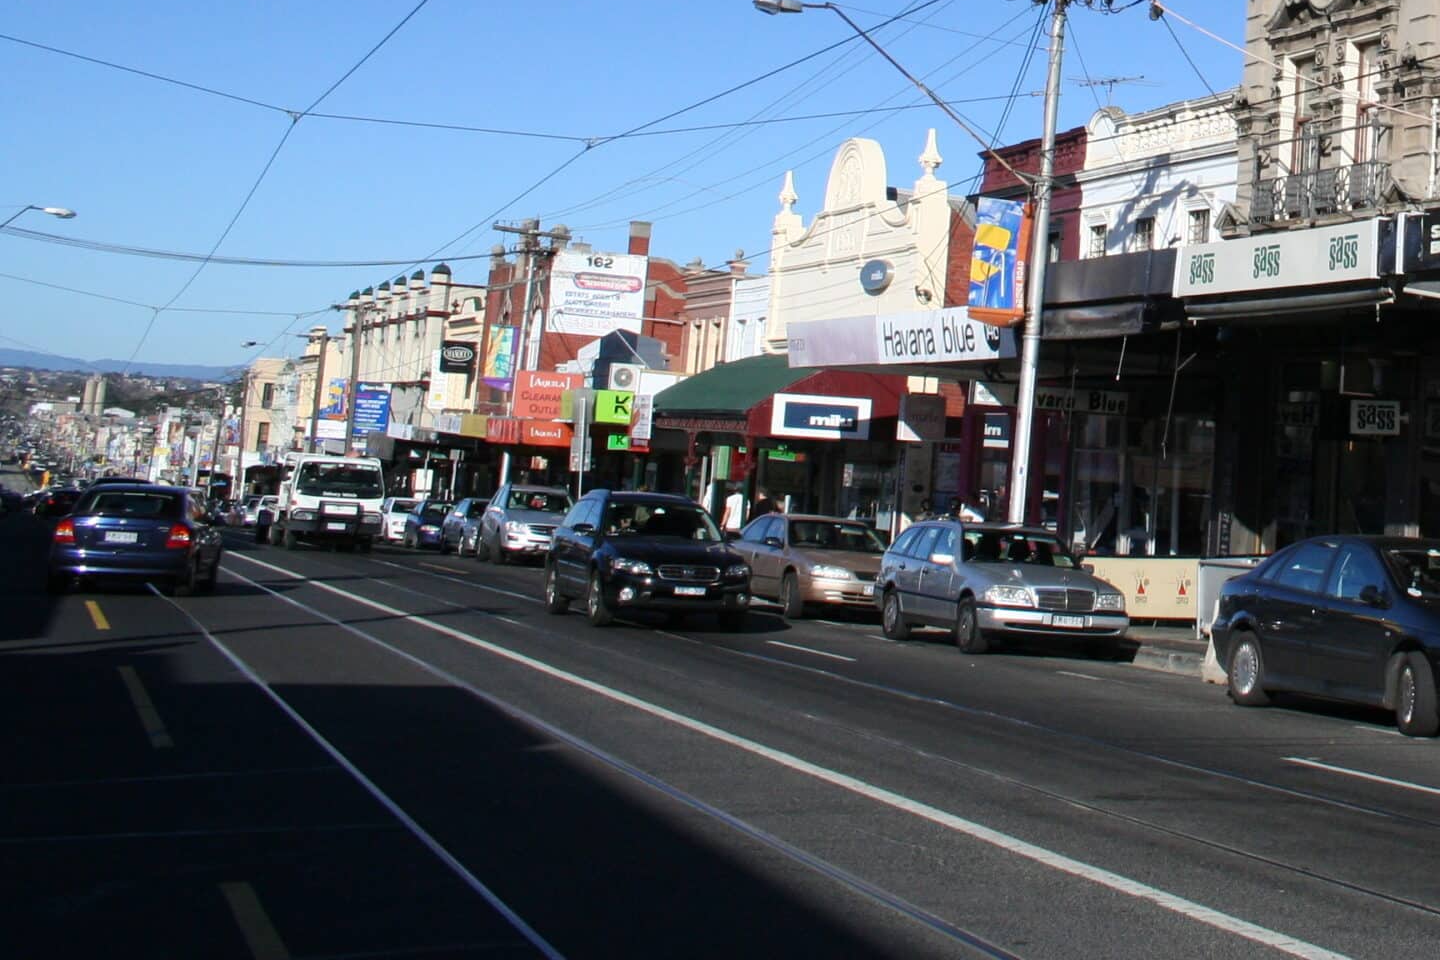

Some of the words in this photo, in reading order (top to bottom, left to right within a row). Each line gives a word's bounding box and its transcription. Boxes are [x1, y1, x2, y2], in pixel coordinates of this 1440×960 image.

[586, 256, 614, 269] 162
[1252, 244, 1281, 279] sass
[1328, 234, 1359, 272] sass
[1189, 253, 1216, 285] sass
[883, 321, 937, 357] Havana
[941, 316, 976, 354] blue
[529, 403, 560, 415] OUTLE
[1088, 392, 1127, 412] Blue
[1358, 404, 1395, 430] sass
